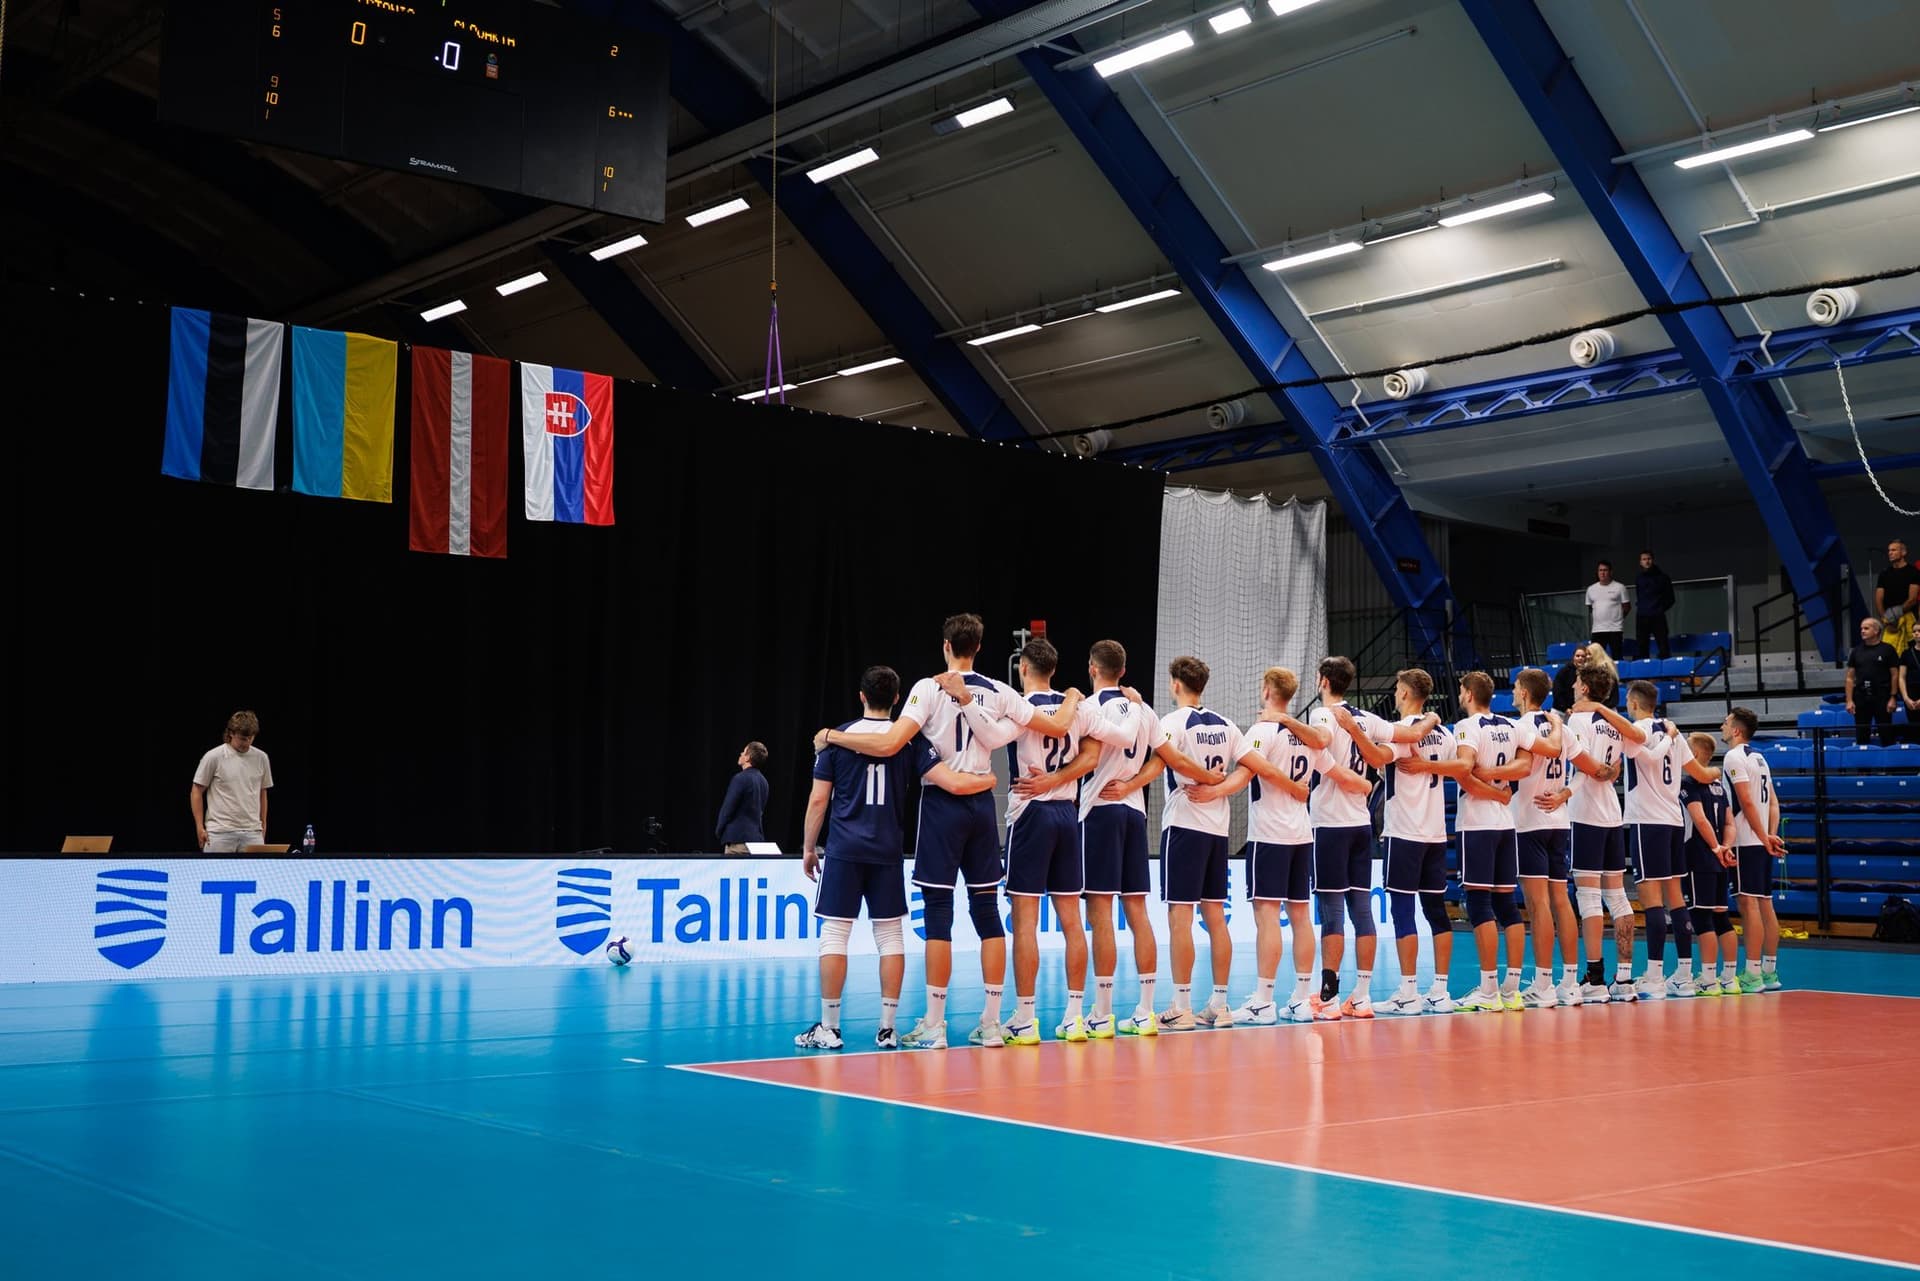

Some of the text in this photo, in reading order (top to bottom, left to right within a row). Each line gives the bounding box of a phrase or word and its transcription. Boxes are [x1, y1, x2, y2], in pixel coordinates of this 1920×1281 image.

[272, 25, 281, 37] 6
[351, 21, 366, 45] 0
[443, 42, 460, 70] 0
[610, 45, 619, 57] 2
[270, 75, 279, 88] 9
[265, 91, 279, 105] 10
[603, 166, 615, 179] 10
[1043, 732, 1071, 773] 22
[1289, 755, 1308, 782] 12
[1662, 754, 1673, 785] 6
[866, 763, 886, 805] 11
[201, 880, 473, 954] Tallinn
[637, 878, 821, 943] Tallin
